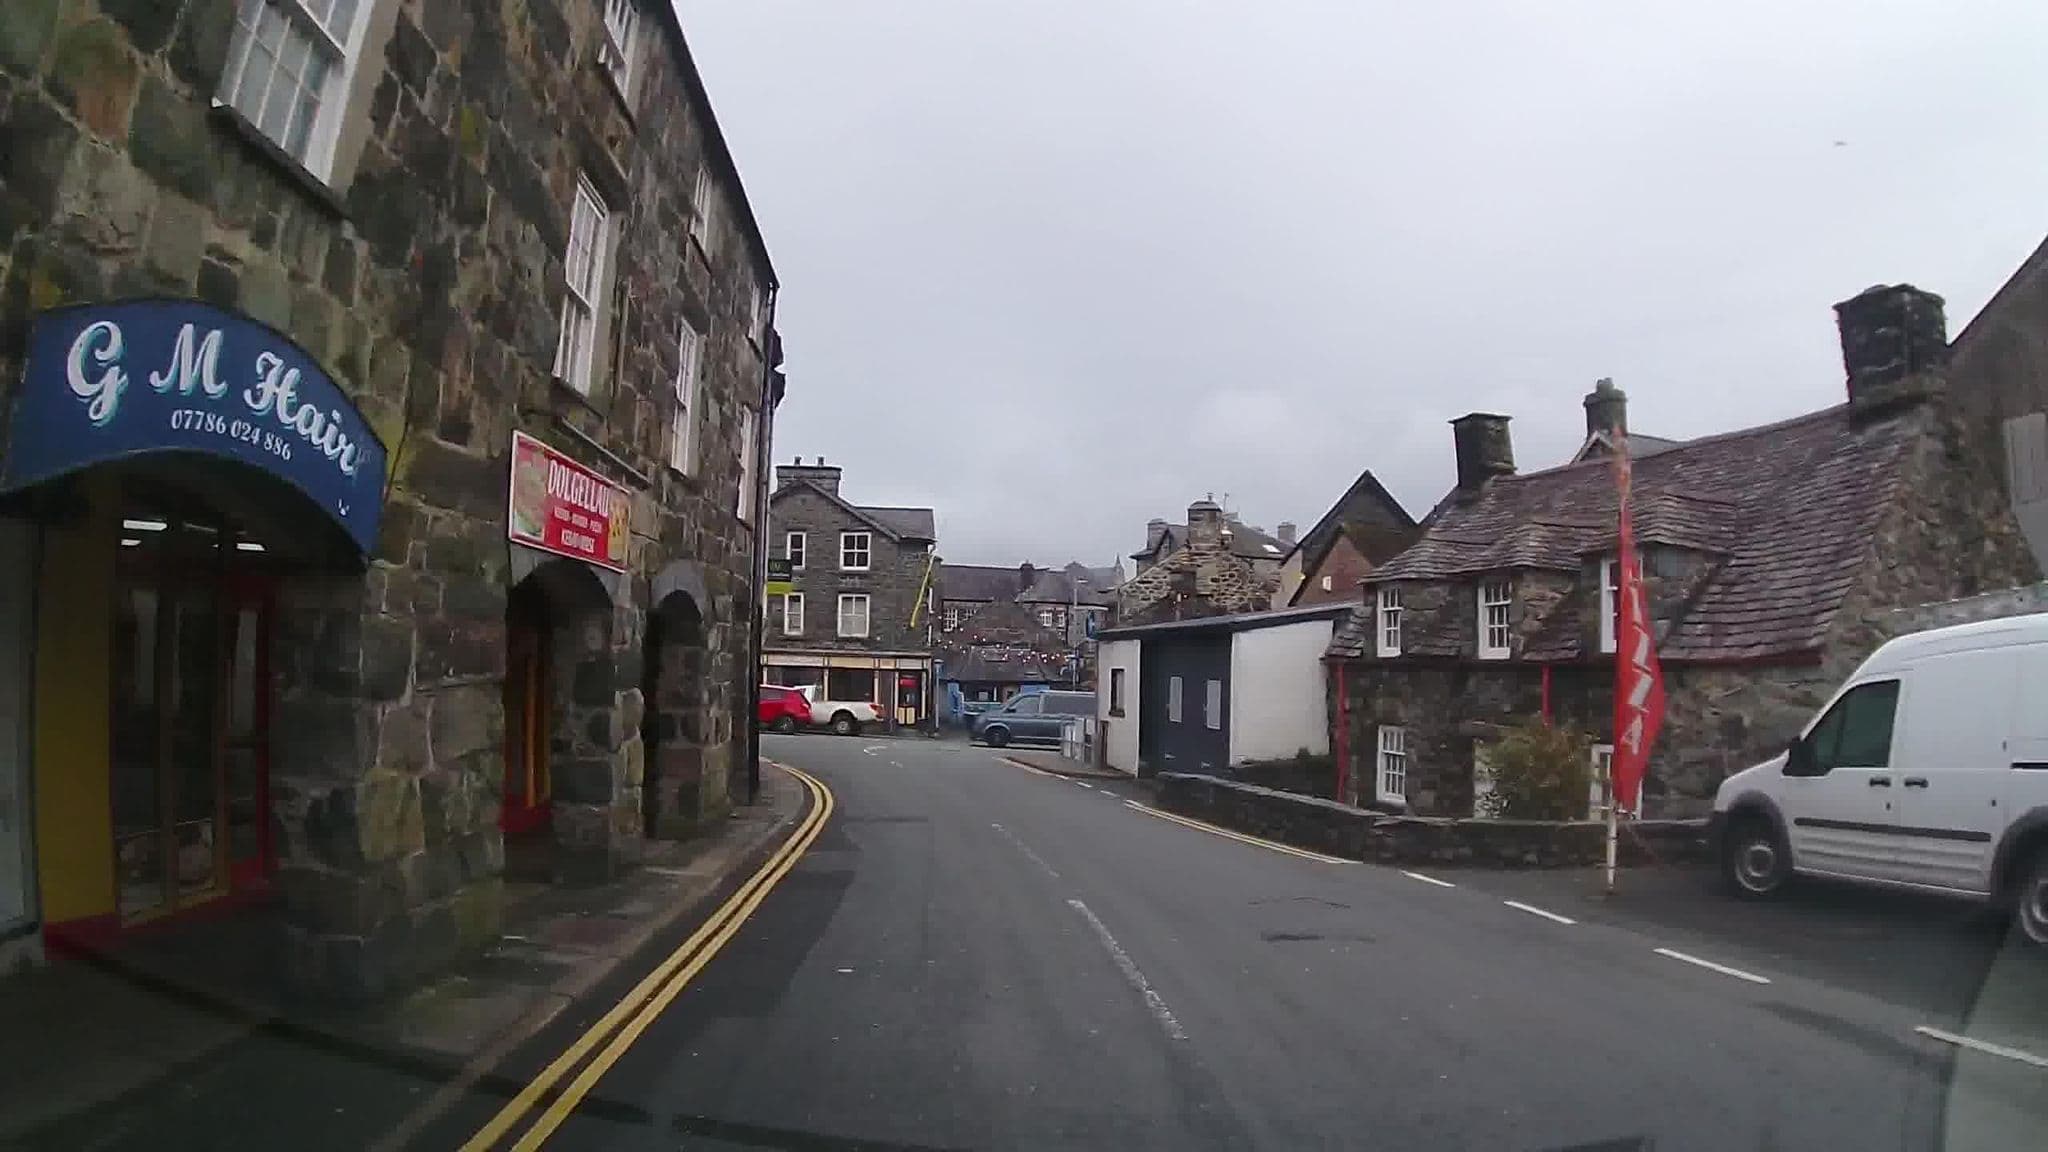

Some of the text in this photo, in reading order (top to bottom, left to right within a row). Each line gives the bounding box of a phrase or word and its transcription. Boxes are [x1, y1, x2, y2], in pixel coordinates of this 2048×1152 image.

[68, 321, 358, 475] G M Hair
[171, 409, 292, 461] 07786 024 886
[547, 459, 609, 517] DOLGELLAU
